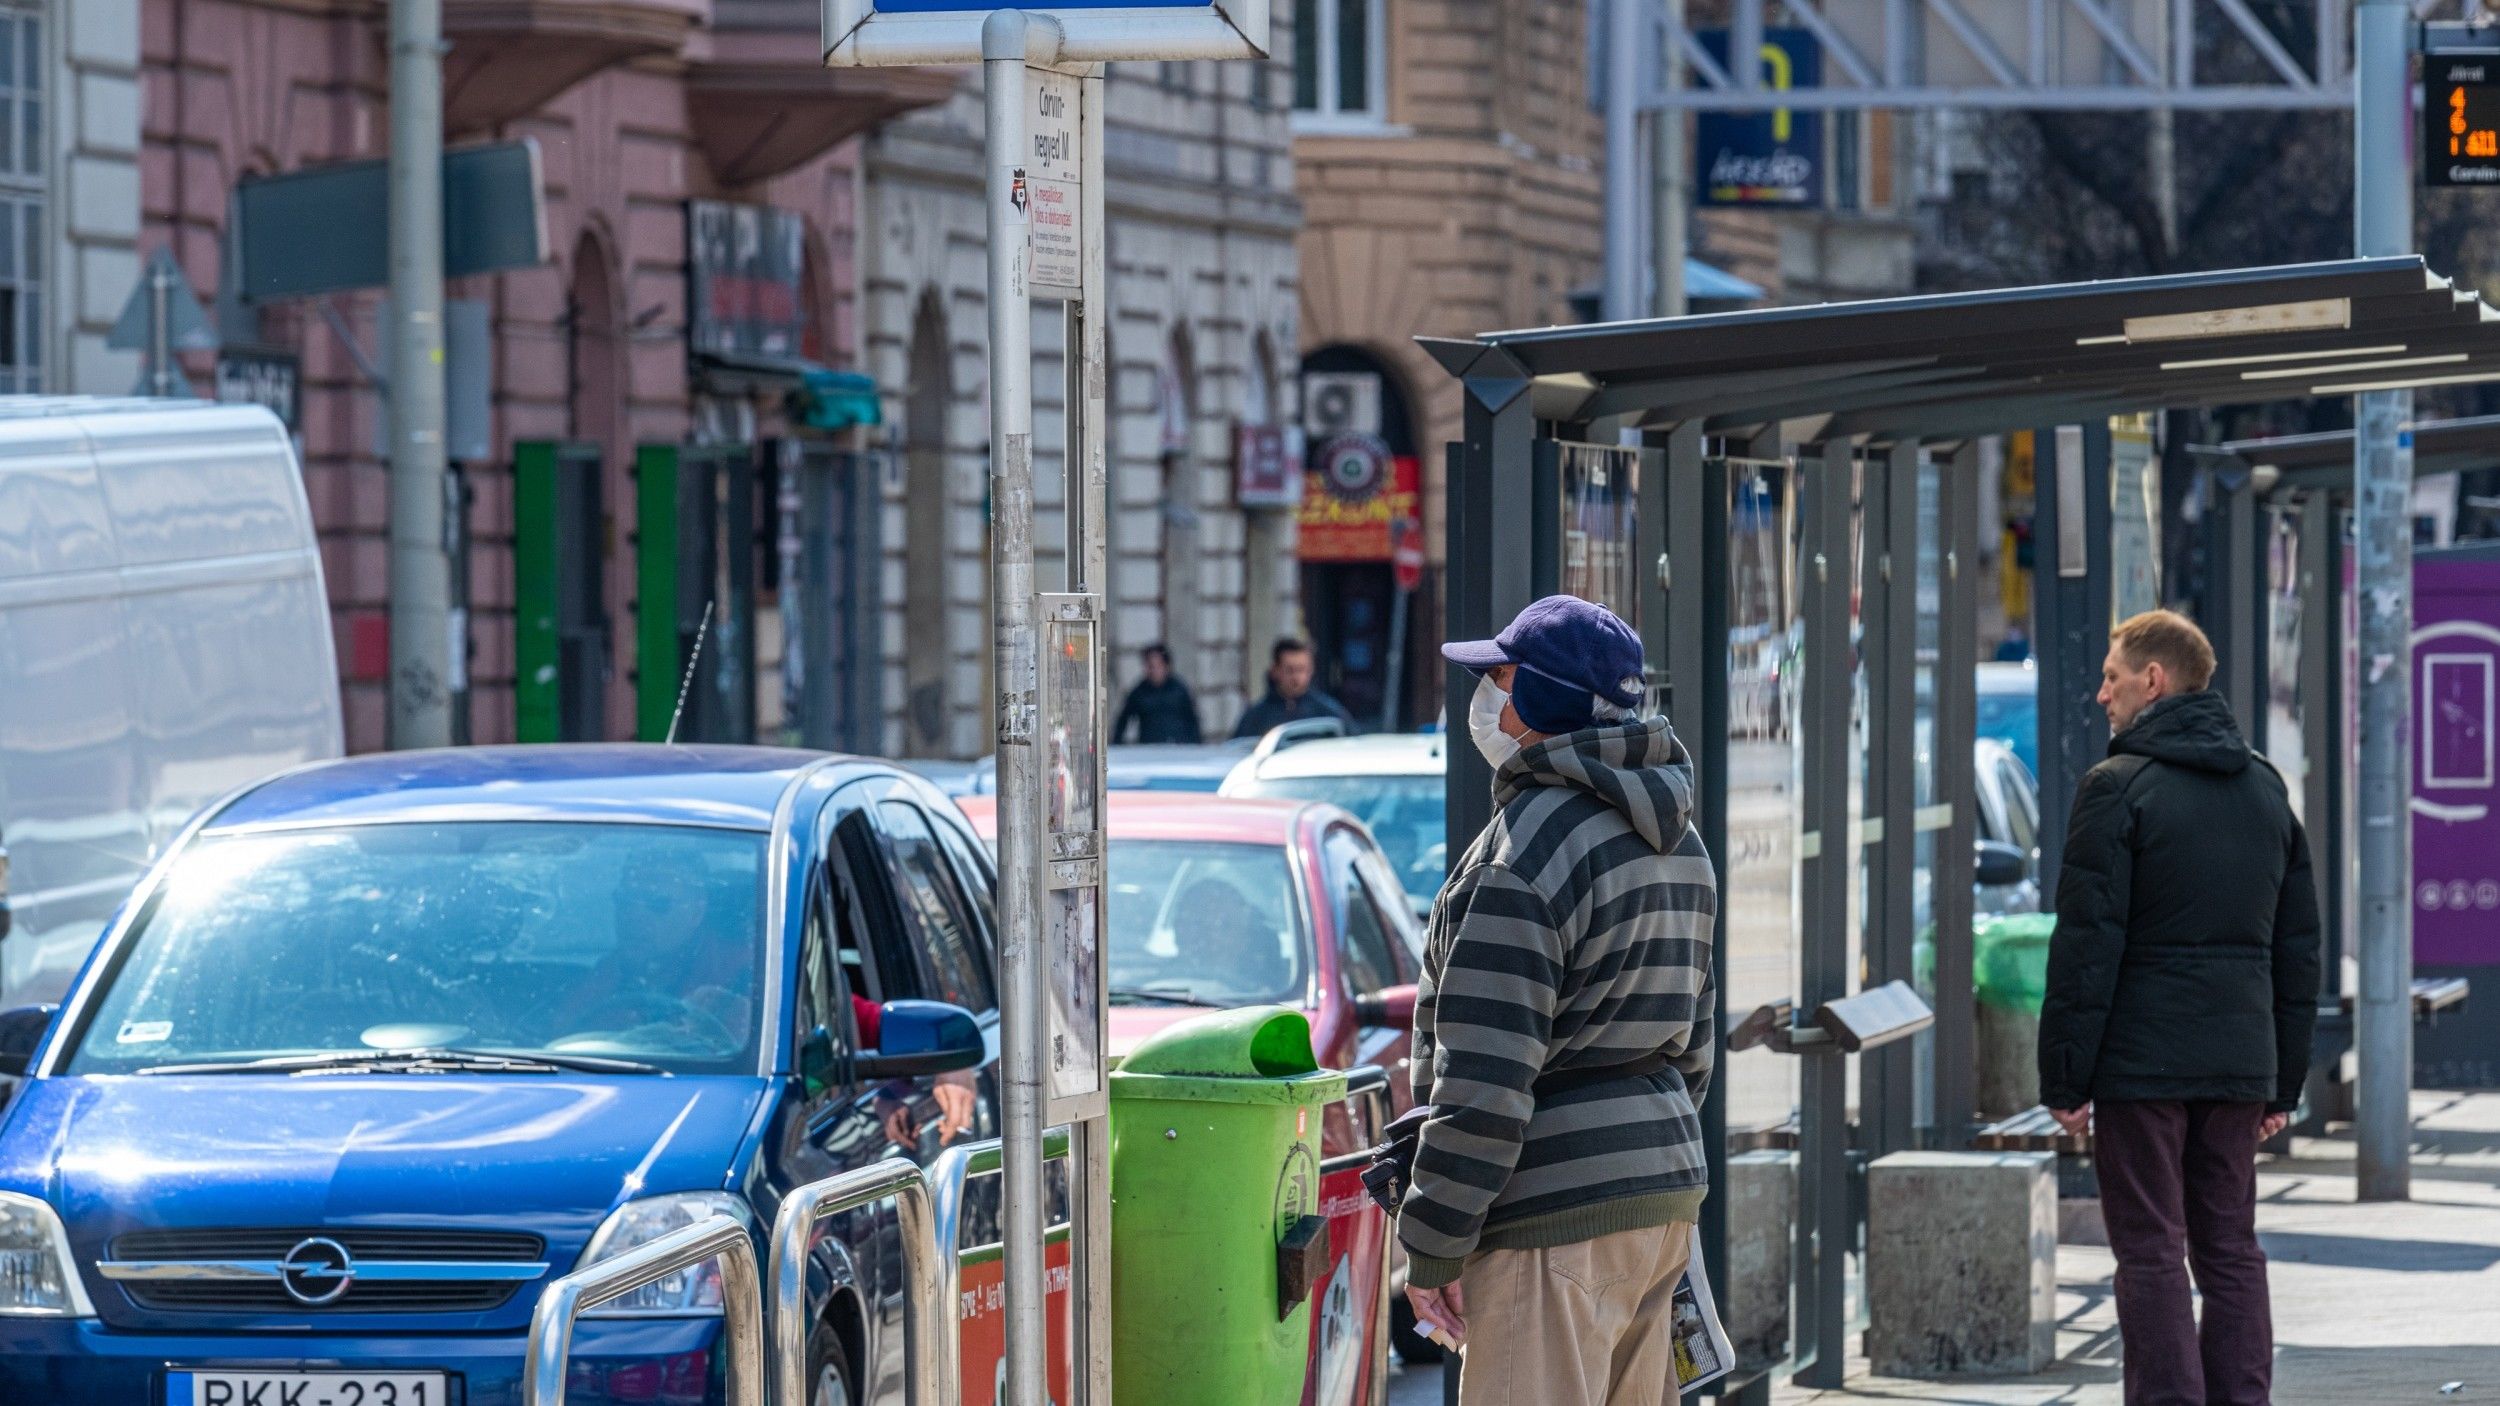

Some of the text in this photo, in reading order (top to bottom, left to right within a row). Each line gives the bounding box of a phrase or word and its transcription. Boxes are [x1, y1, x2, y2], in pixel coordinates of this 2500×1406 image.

[1040, 86, 1064, 118] Corvin-
[1034, 128, 1069, 168] negyed M
[205, 1380, 426, 1406] RKK-231
